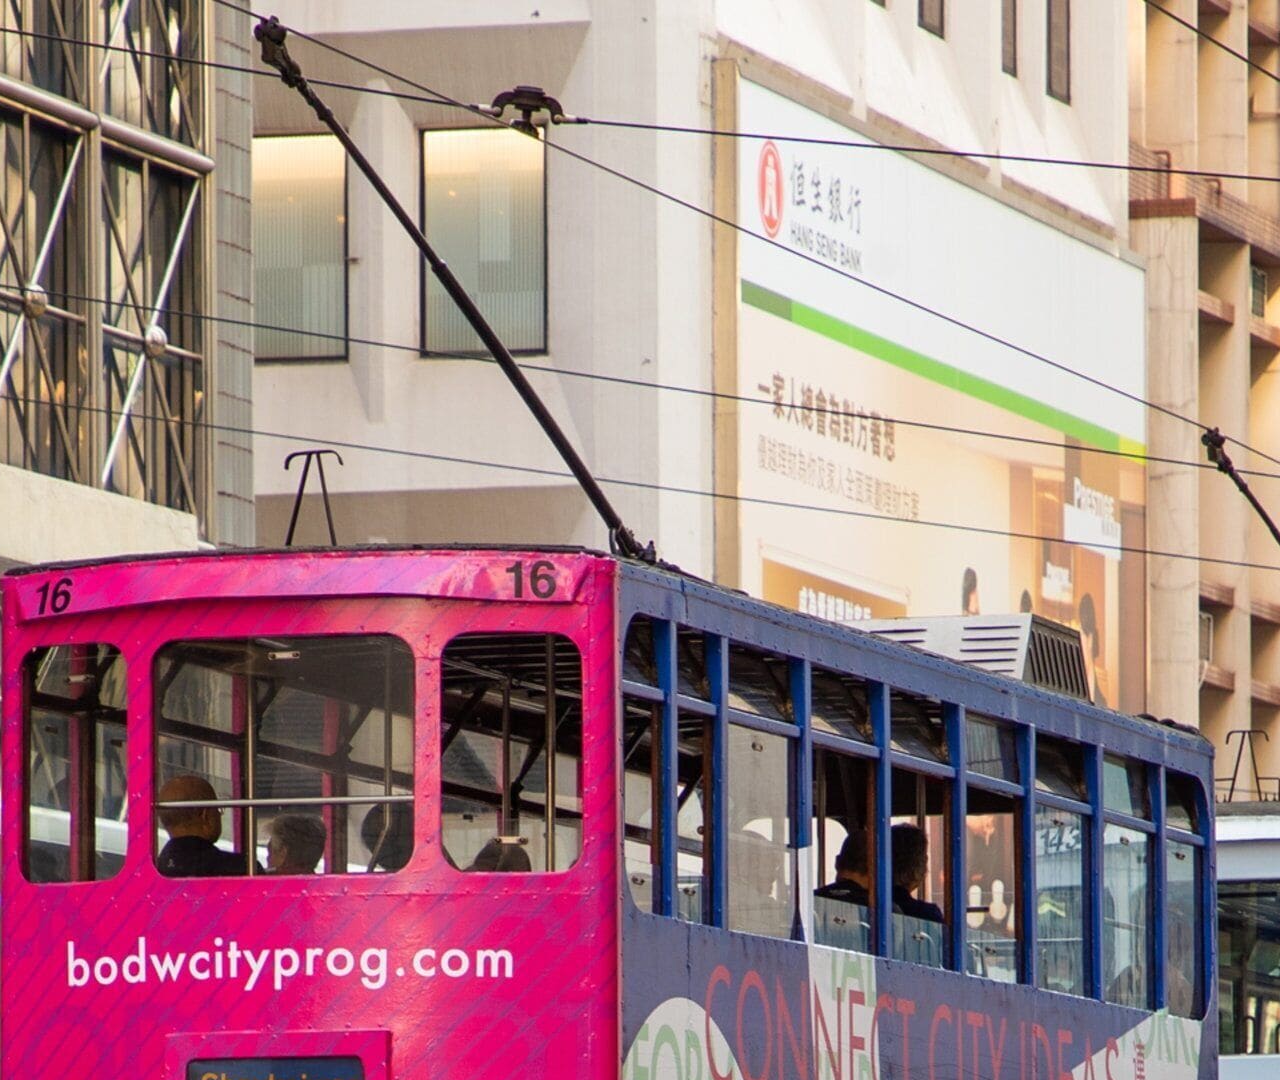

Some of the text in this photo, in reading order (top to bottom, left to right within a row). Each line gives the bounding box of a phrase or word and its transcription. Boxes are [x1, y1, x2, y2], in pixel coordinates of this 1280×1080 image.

[790, 219, 863, 273] HANG SENG BANK
[35, 577, 72, 615] 16
[505, 559, 557, 600] 16
[66, 937, 514, 991] bodwcityprog.com
